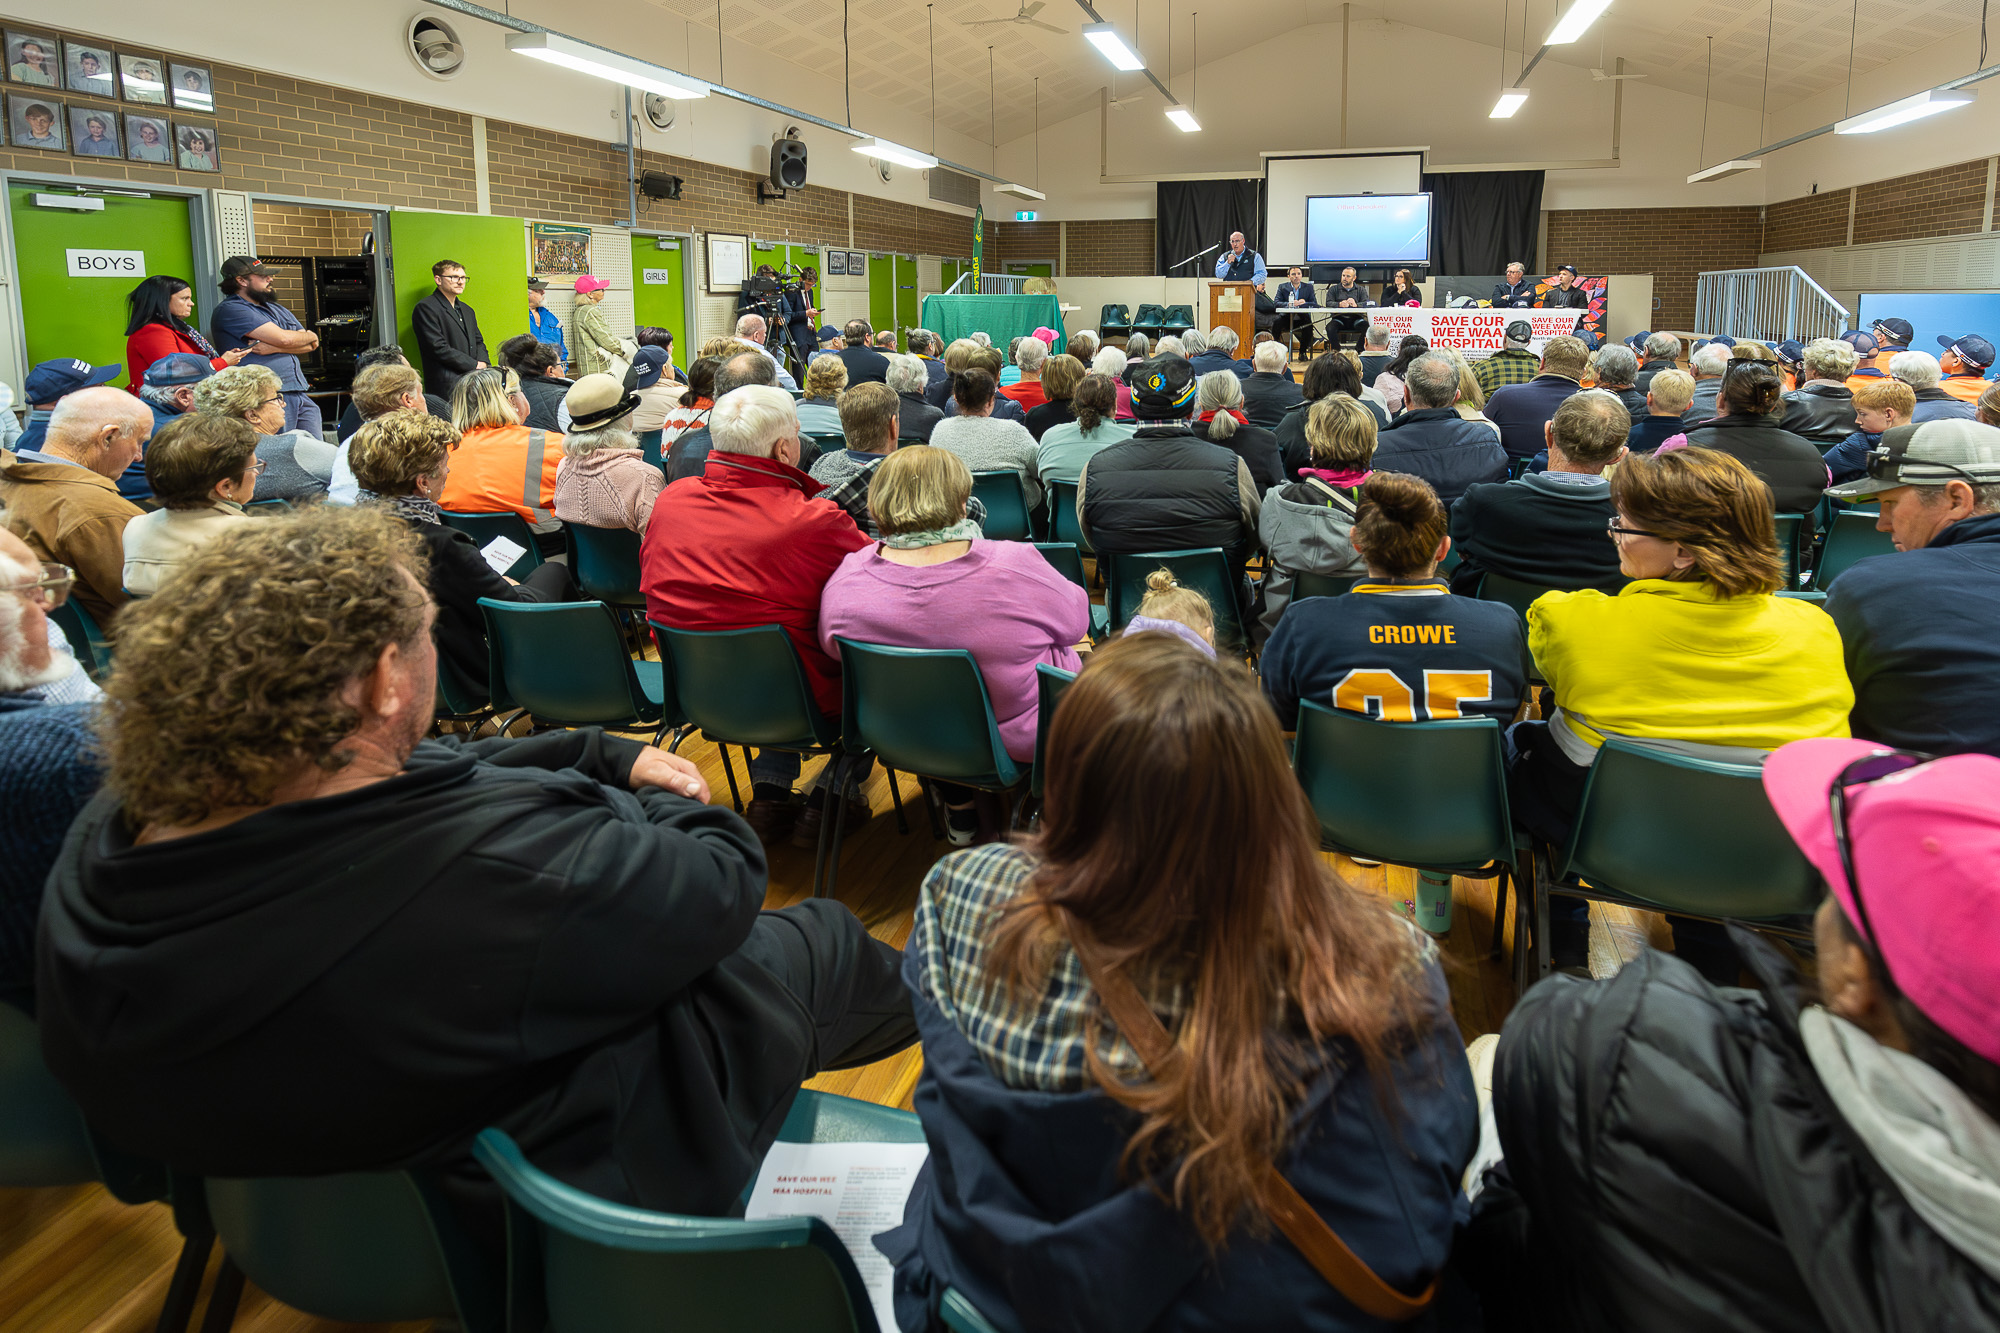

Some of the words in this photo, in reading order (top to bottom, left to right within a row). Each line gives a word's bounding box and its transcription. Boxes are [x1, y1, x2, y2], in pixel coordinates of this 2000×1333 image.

[78, 256, 136, 270] BOYS
[646, 272, 666, 281] GIRLS
[1373, 315, 1394, 323] SAVE
[1431, 315, 1469, 326] SAVE
[1472, 316, 1504, 326] OUR
[1432, 327, 1465, 337] WEE
[1468, 327, 1503, 337] WAA
[1430, 338, 1503, 349] HOSPITAL
[1368, 624, 1457, 644] CROWE
[776, 1175, 798, 1183] SAVE
[800, 1175, 817, 1183] OUR
[819, 1175, 837, 1183] WEE
[772, 1187, 791, 1195] WAA
[793, 1187, 833, 1196] HOSPITAL
